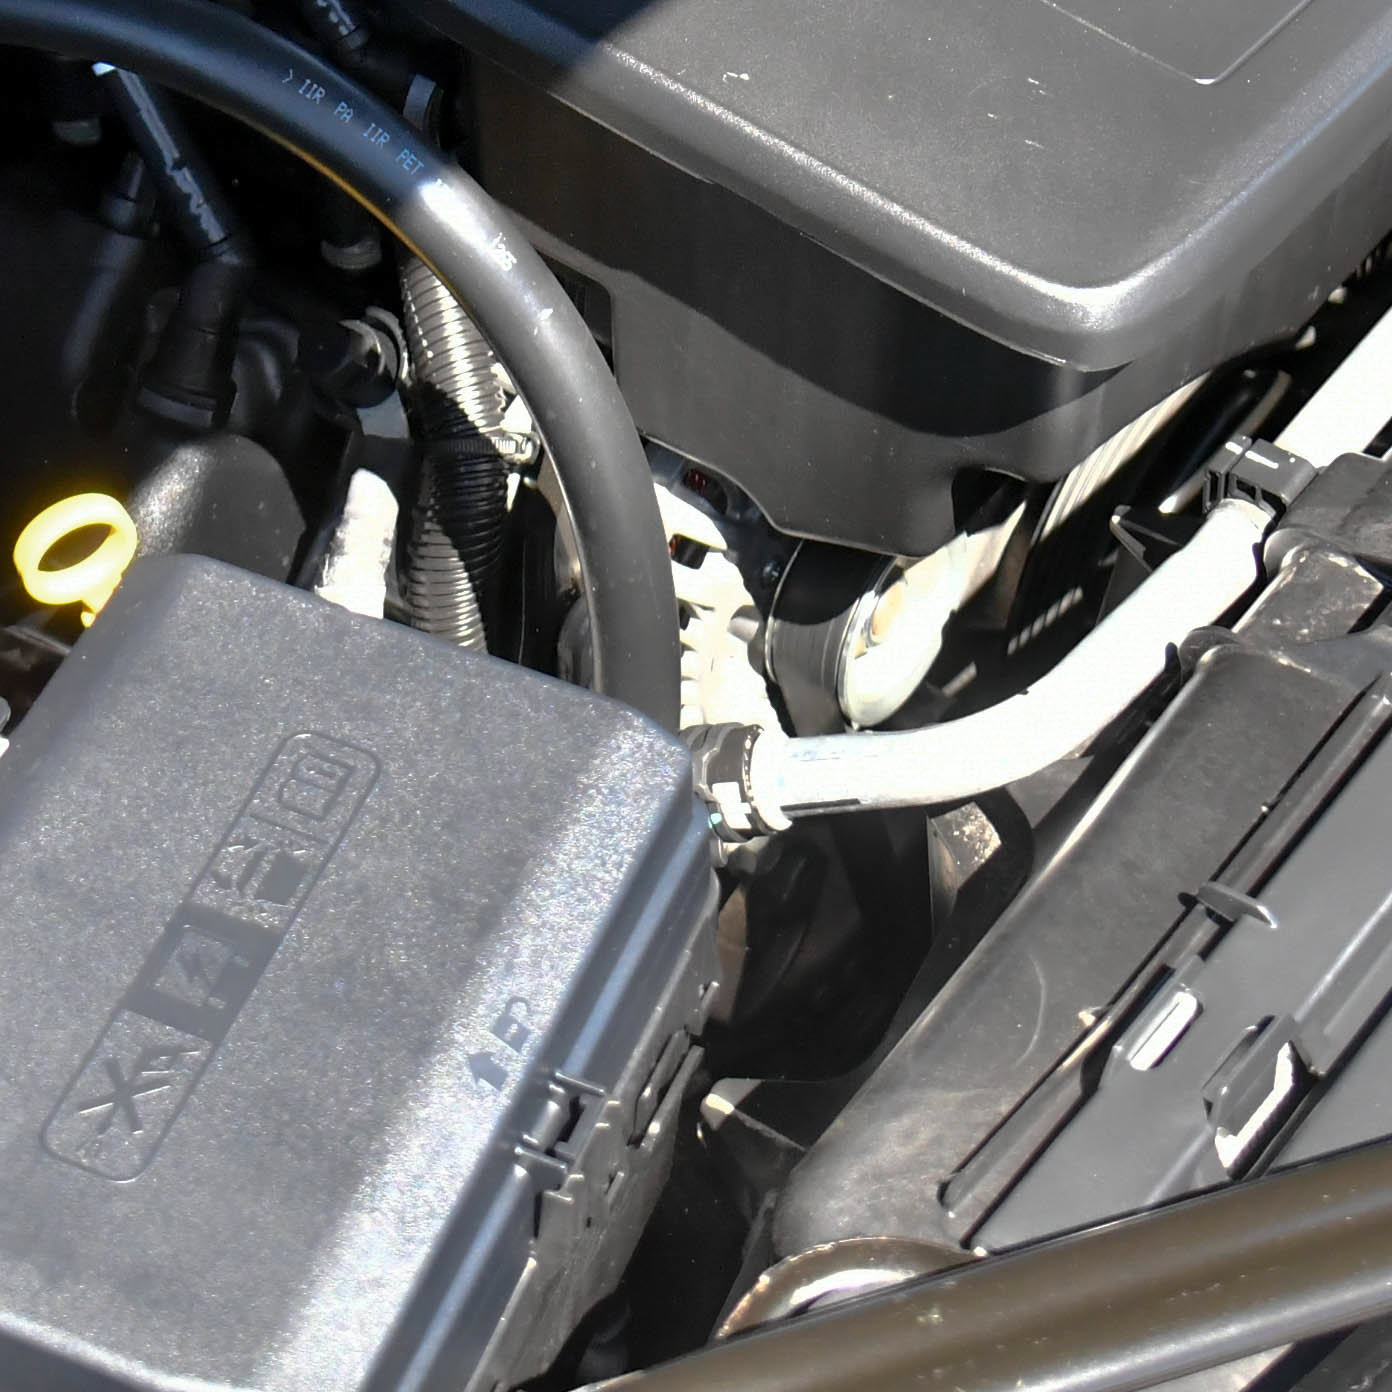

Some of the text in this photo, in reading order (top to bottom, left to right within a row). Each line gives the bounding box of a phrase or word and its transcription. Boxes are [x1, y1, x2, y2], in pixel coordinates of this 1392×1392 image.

[333, 101, 355, 124] PA
[363, 122, 391, 148] IIR
[395, 148, 425, 175] PET
